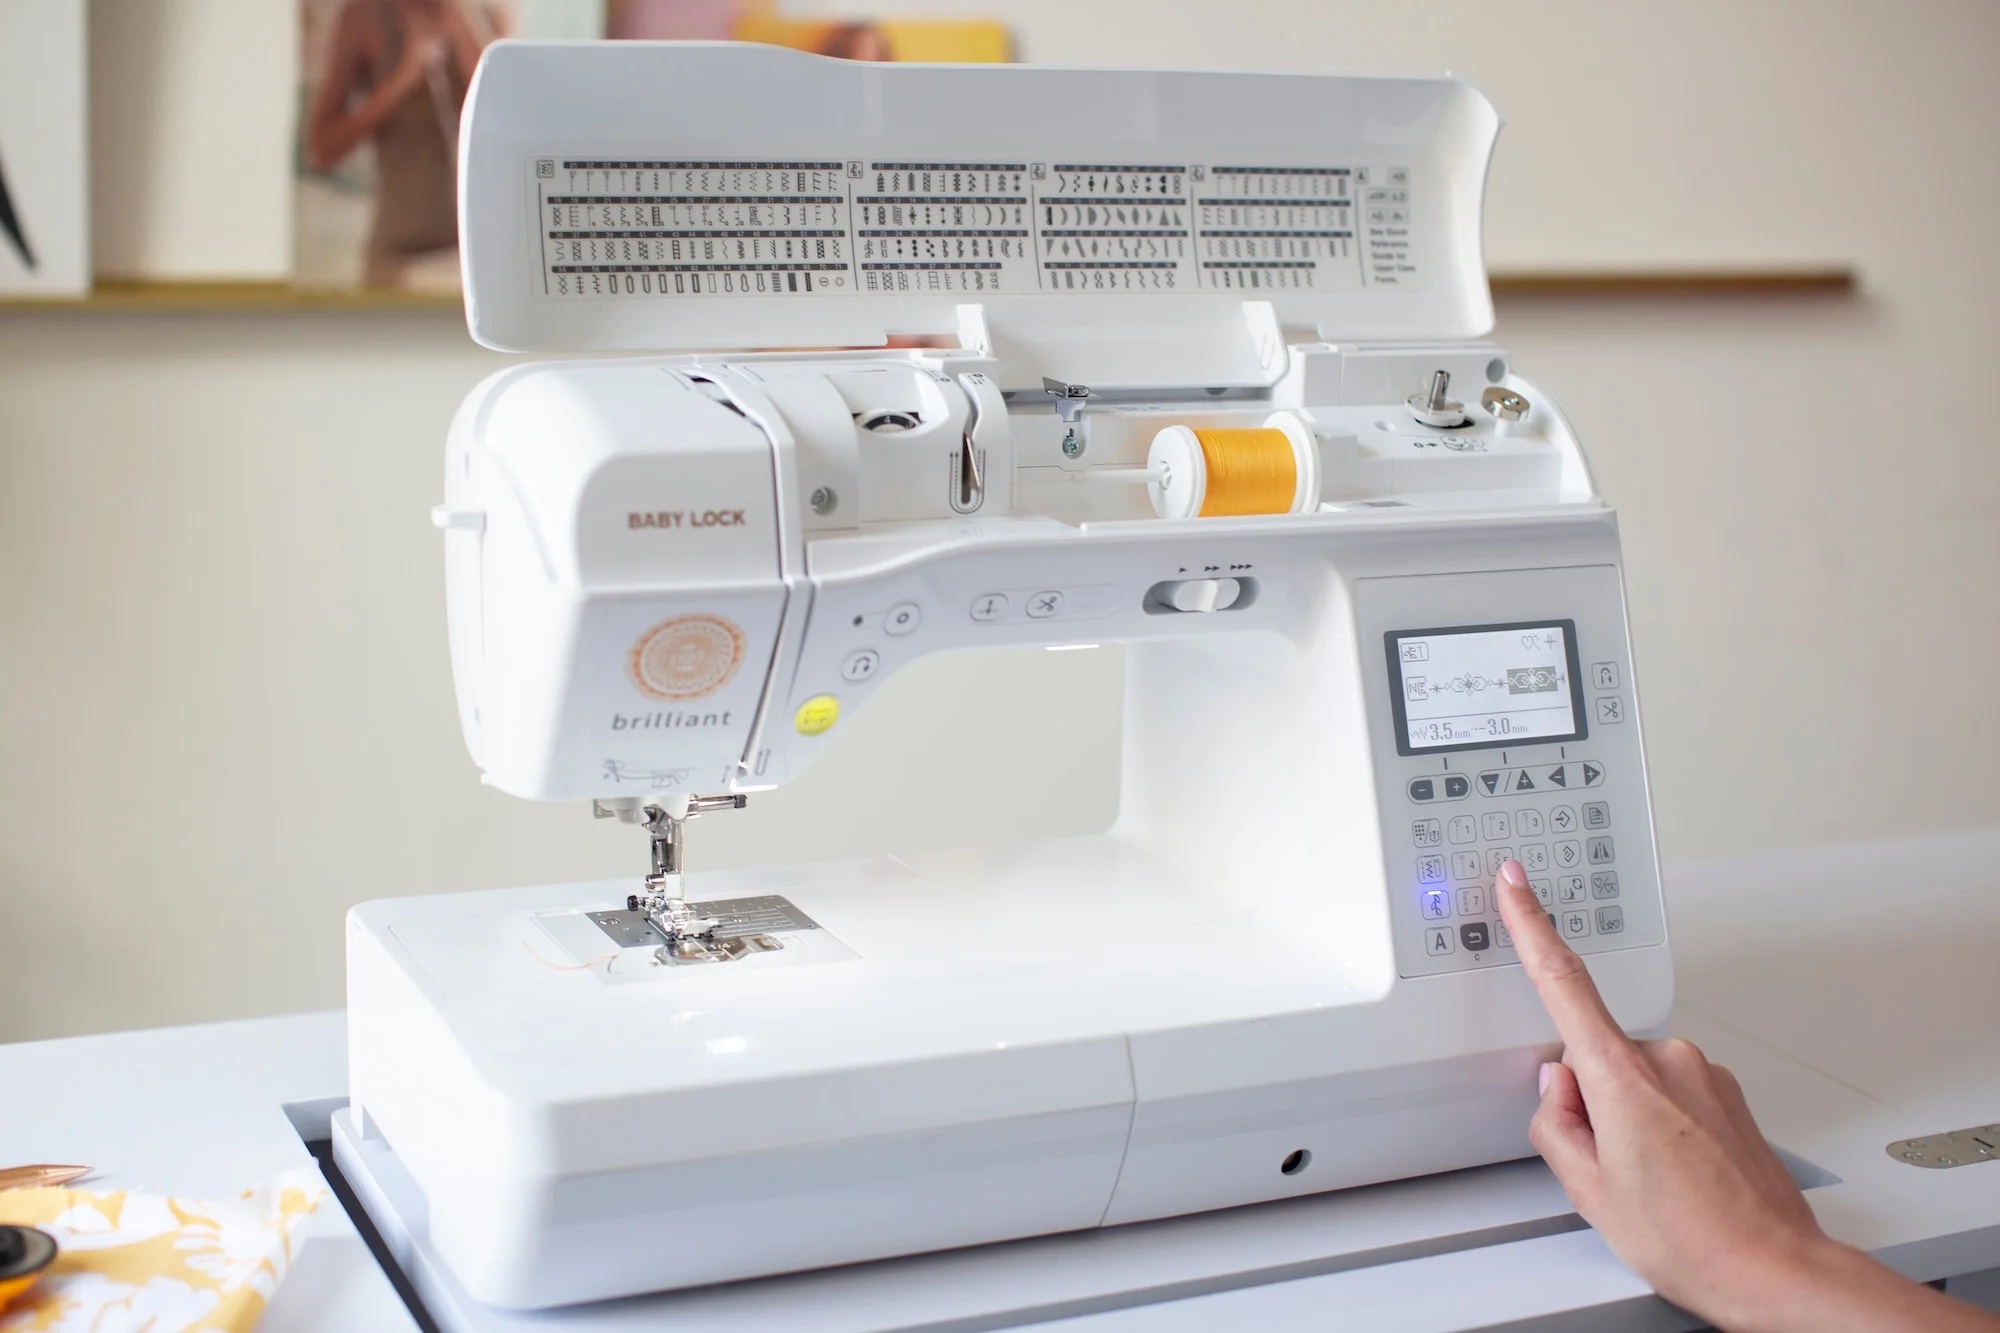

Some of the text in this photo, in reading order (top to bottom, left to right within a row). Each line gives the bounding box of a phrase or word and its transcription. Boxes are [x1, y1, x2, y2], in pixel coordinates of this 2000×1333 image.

[628, 510, 746, 529] BABY LOCK
[611, 711, 732, 731] brilliant
[1499, 822, 1505, 831] 2
[1532, 818, 1539, 827] 3
[1537, 853, 1543, 862] 6
[1469, 860, 1475, 870] 4
[1541, 888, 1547, 898] 9
[1473, 896, 1479, 906] 7
[1435, 933, 1447, 951] A
